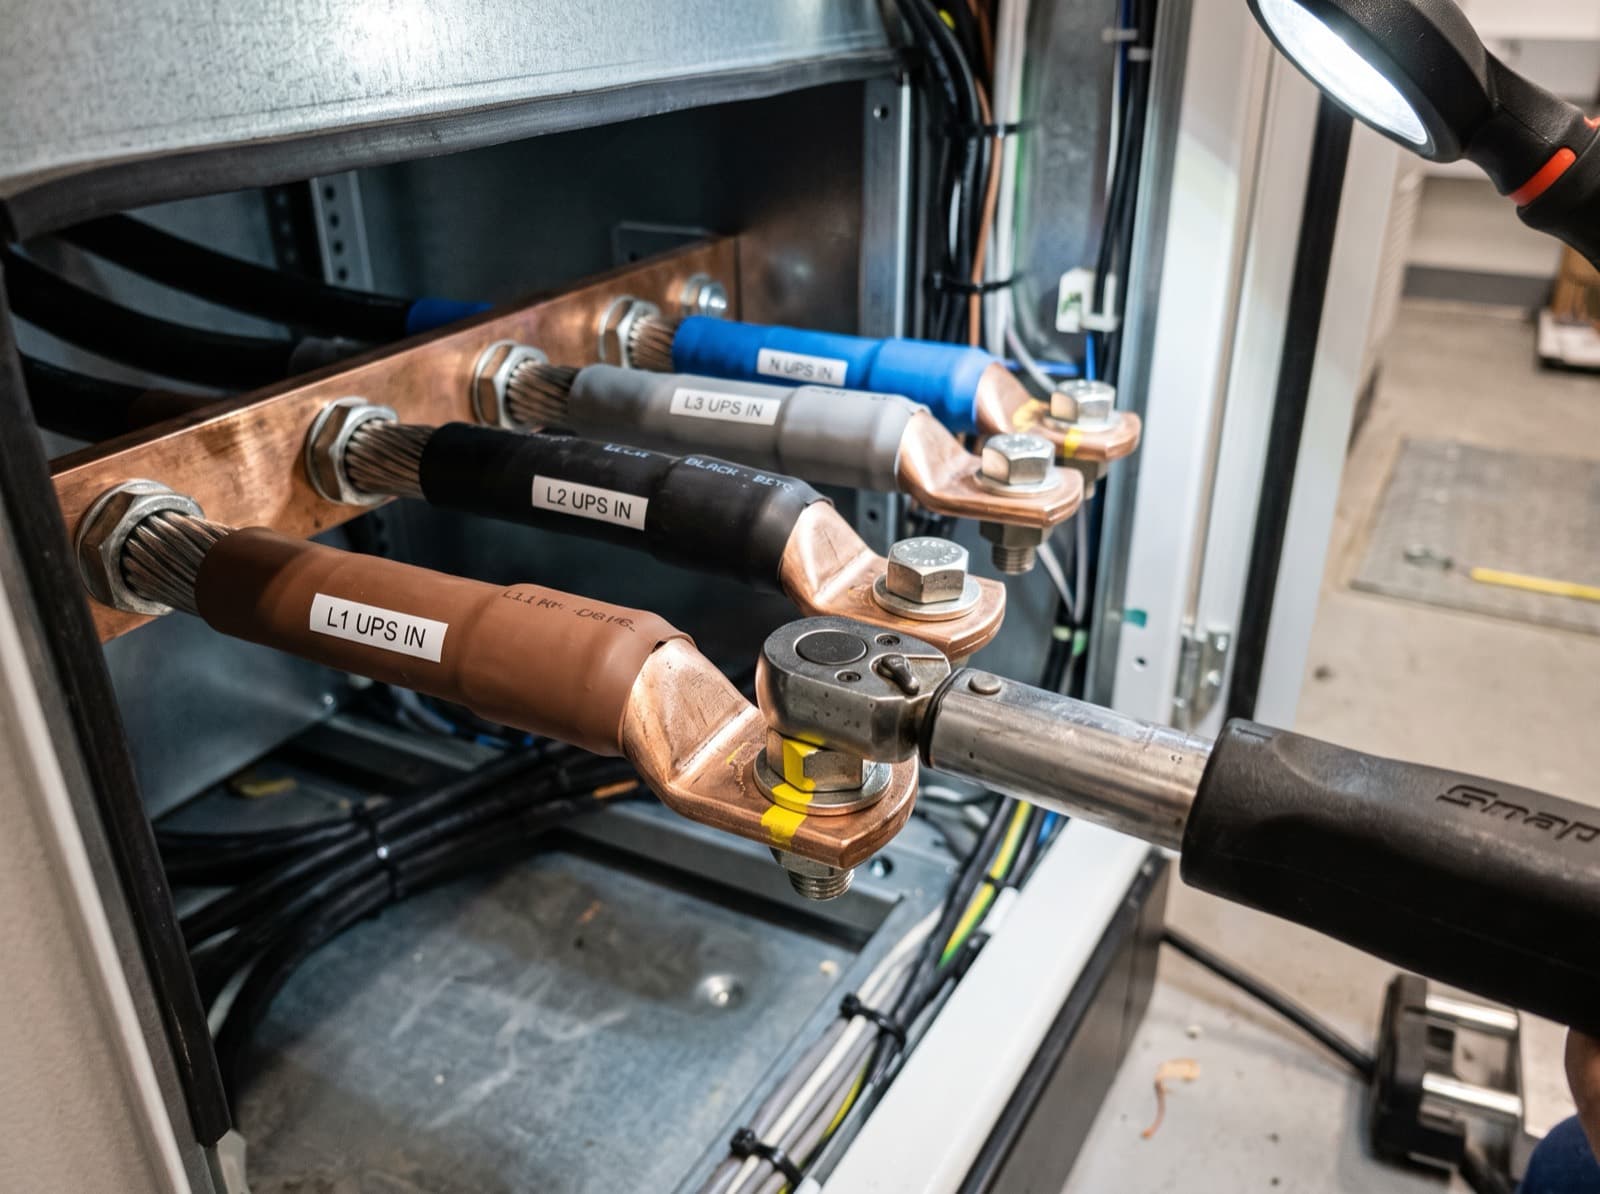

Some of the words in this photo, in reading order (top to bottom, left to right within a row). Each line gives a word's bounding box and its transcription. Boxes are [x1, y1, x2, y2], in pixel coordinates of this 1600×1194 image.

[769, 356, 780, 371] N
[783, 360, 814, 378] UPS
[817, 366, 834, 381] IN
[684, 395, 704, 411] L3
[708, 399, 742, 416] UPS
[746, 403, 765, 418] IN
[546, 486, 567, 506] L2
[571, 492, 608, 515] UPS
[613, 501, 632, 520] IN
[326, 606, 349, 630] L1
[356, 613, 398, 642] UPS
[403, 625, 426, 649] IN
[1435, 784, 1600, 842] Snap
